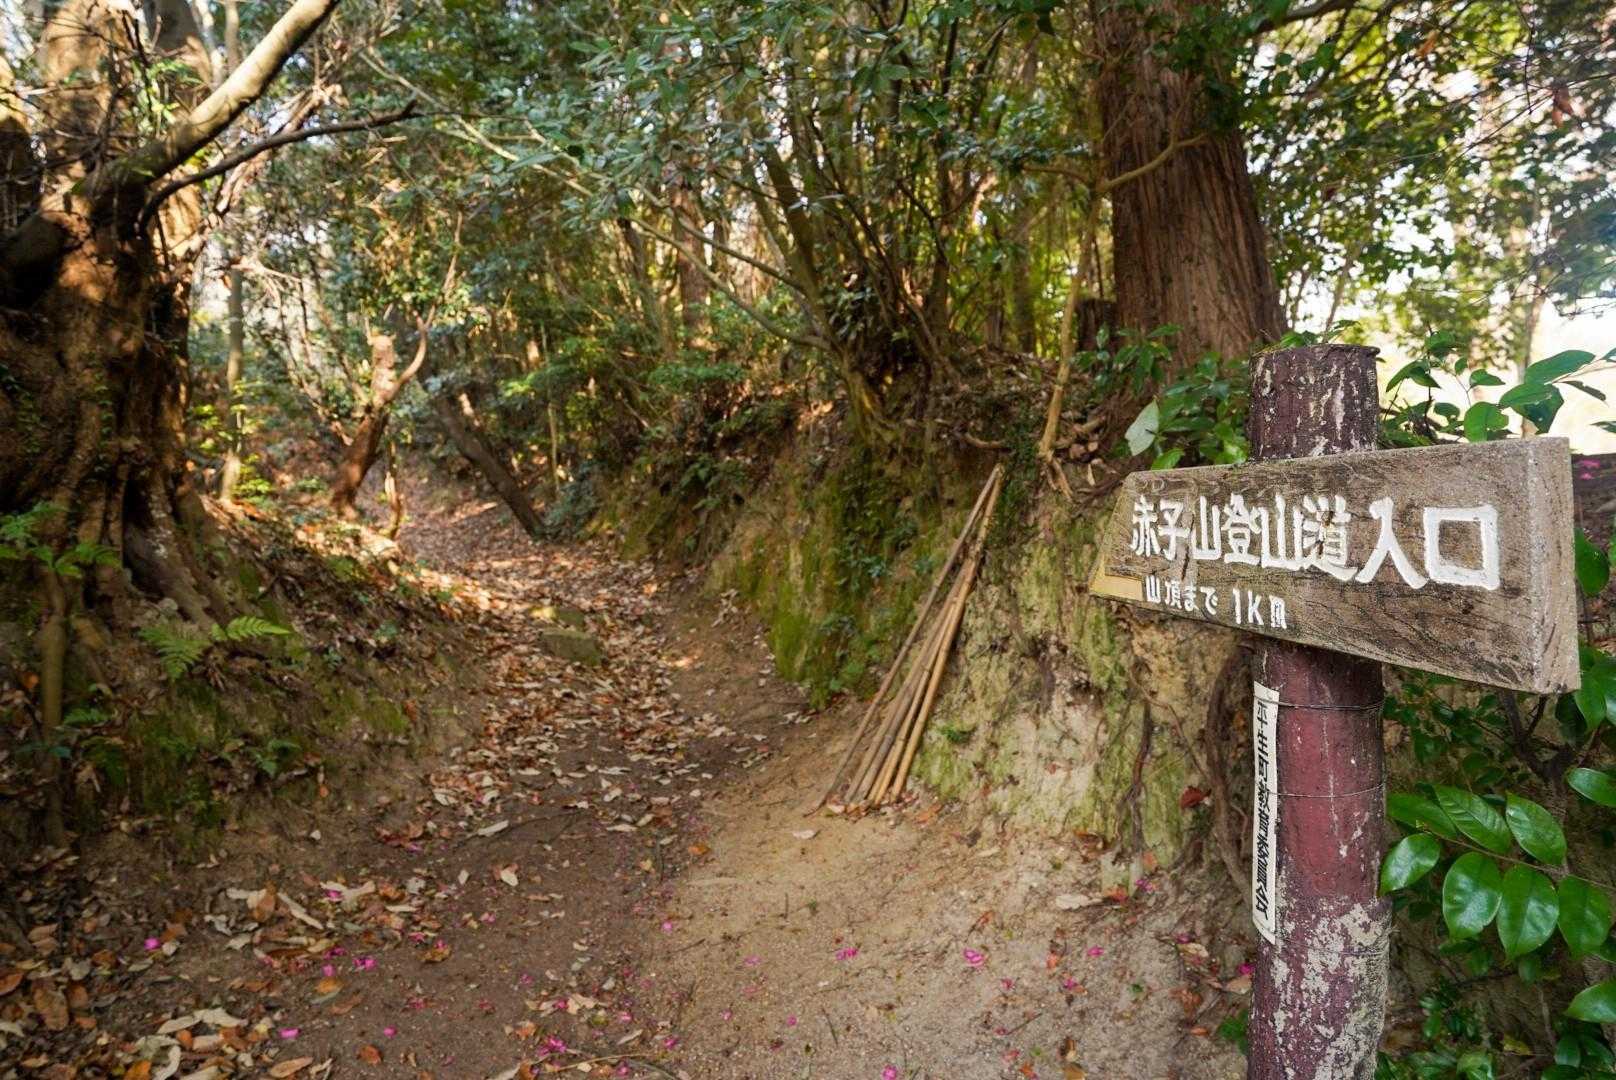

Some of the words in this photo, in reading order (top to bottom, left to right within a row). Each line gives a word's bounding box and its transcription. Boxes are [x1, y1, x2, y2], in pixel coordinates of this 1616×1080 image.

[1129, 493, 1501, 591] 赤子山登山道入口
[1145, 574, 1219, 616] 山頂まで
